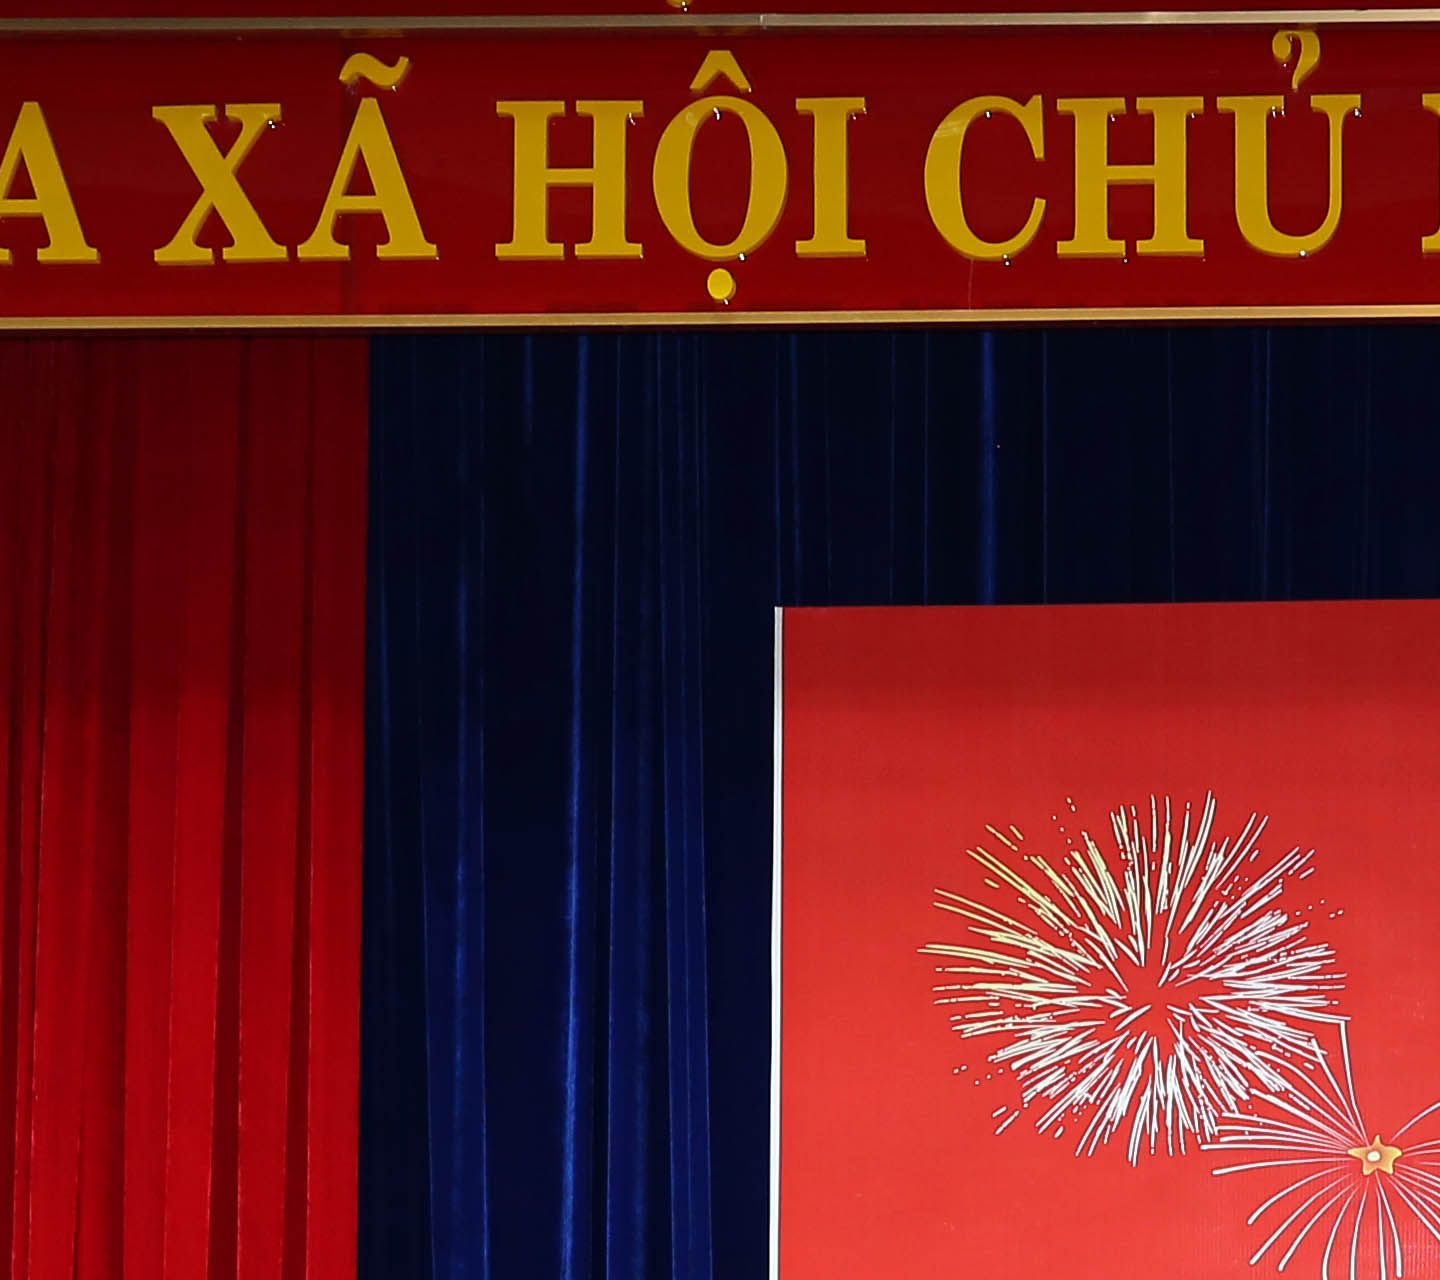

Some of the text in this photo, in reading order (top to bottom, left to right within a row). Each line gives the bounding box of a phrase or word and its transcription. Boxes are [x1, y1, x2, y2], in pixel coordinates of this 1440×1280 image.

[152, 52, 439, 265] XÃ
[495, 50, 868, 304] HỘI
[924, 29, 1363, 261] CHỦ
